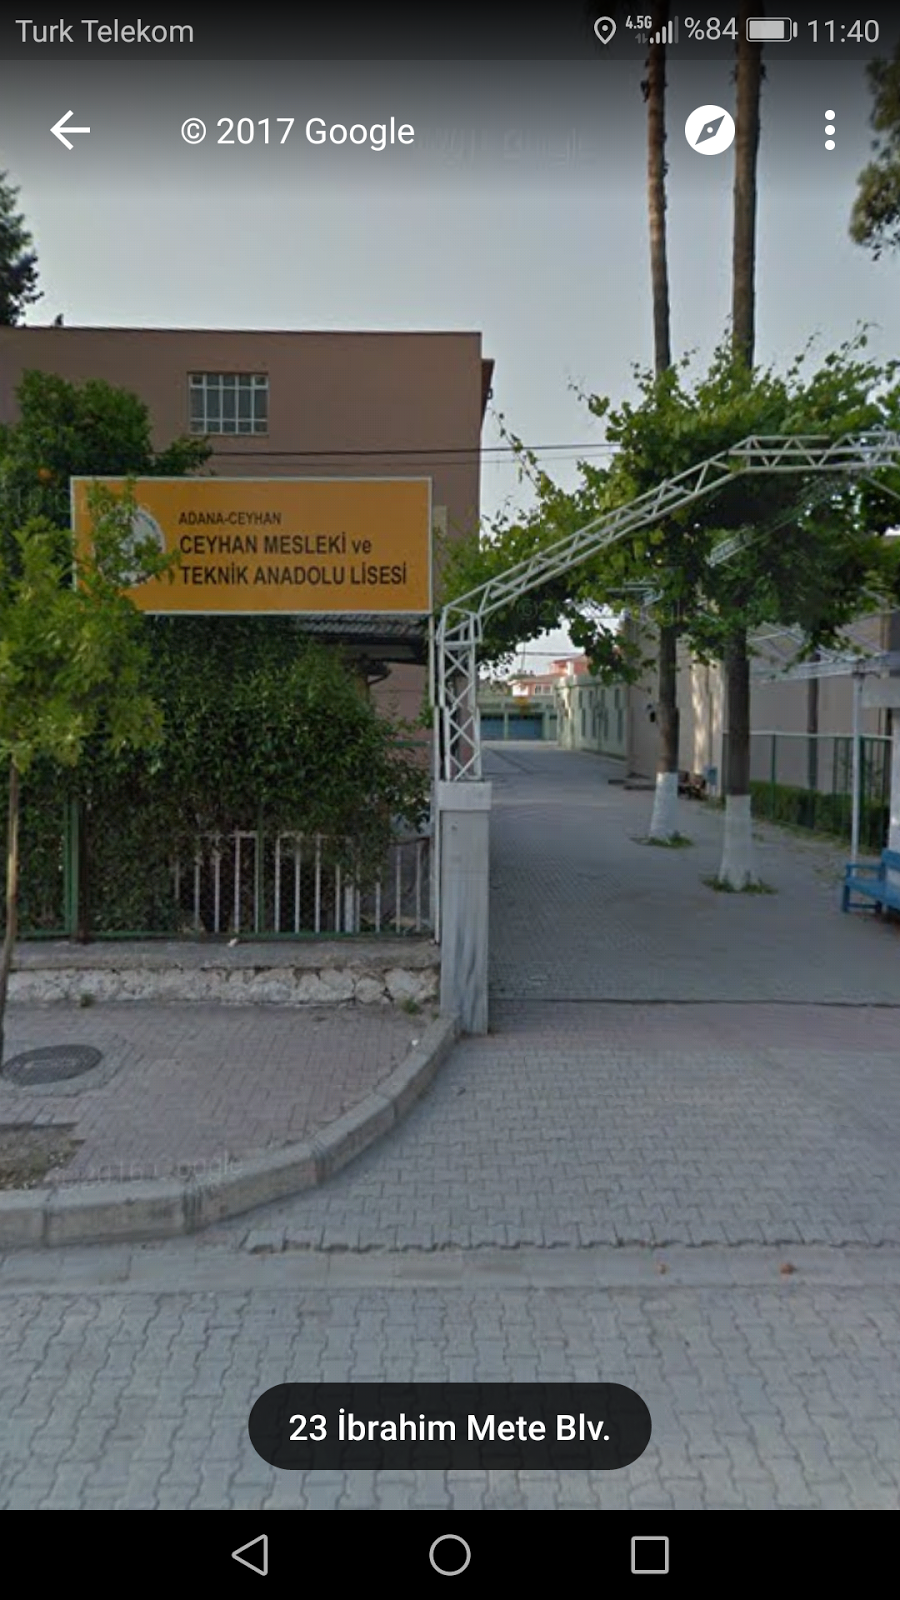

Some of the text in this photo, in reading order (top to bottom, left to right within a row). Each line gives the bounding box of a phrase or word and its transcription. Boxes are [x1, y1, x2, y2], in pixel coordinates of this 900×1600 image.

[178, 510, 281, 525] ADANA-CEYHAN
[180, 532, 372, 556] CEYHAN MESLEKİ ve
[181, 562, 406, 585] TEKNİK ANADOLU LİSESİ
